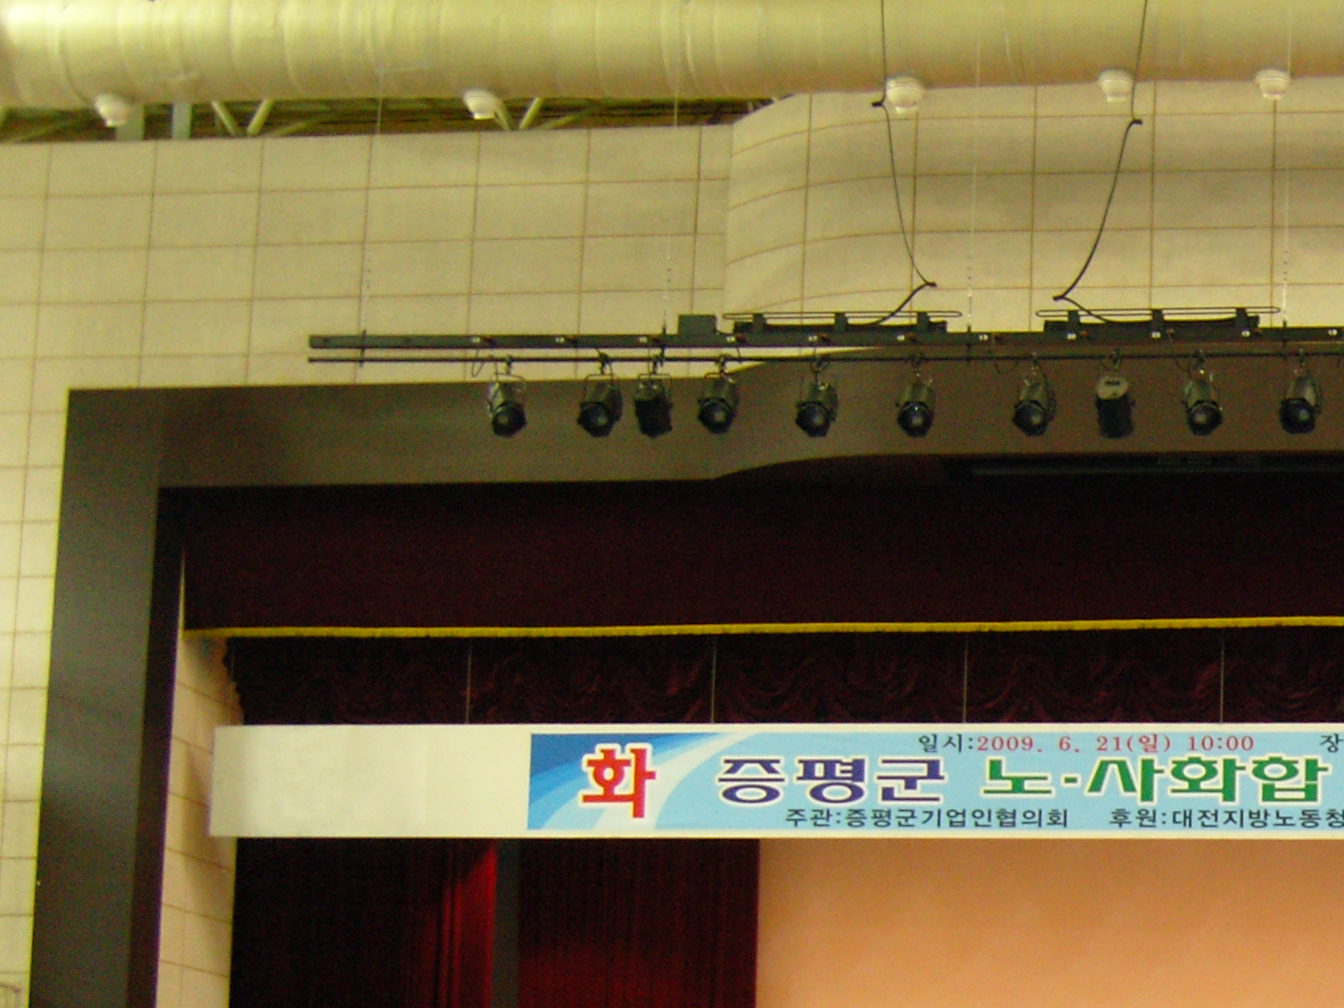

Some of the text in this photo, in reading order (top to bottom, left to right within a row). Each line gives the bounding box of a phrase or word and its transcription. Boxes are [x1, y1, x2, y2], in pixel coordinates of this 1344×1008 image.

[1096, 734, 1170, 753] 21(일)
[1188, 735, 1254, 751] 10:00
[582, 748, 656, 818] 화
[718, 758, 944, 803] 증평군
[785, 808, 1068, 829] 주관:증평군기업인협의회
